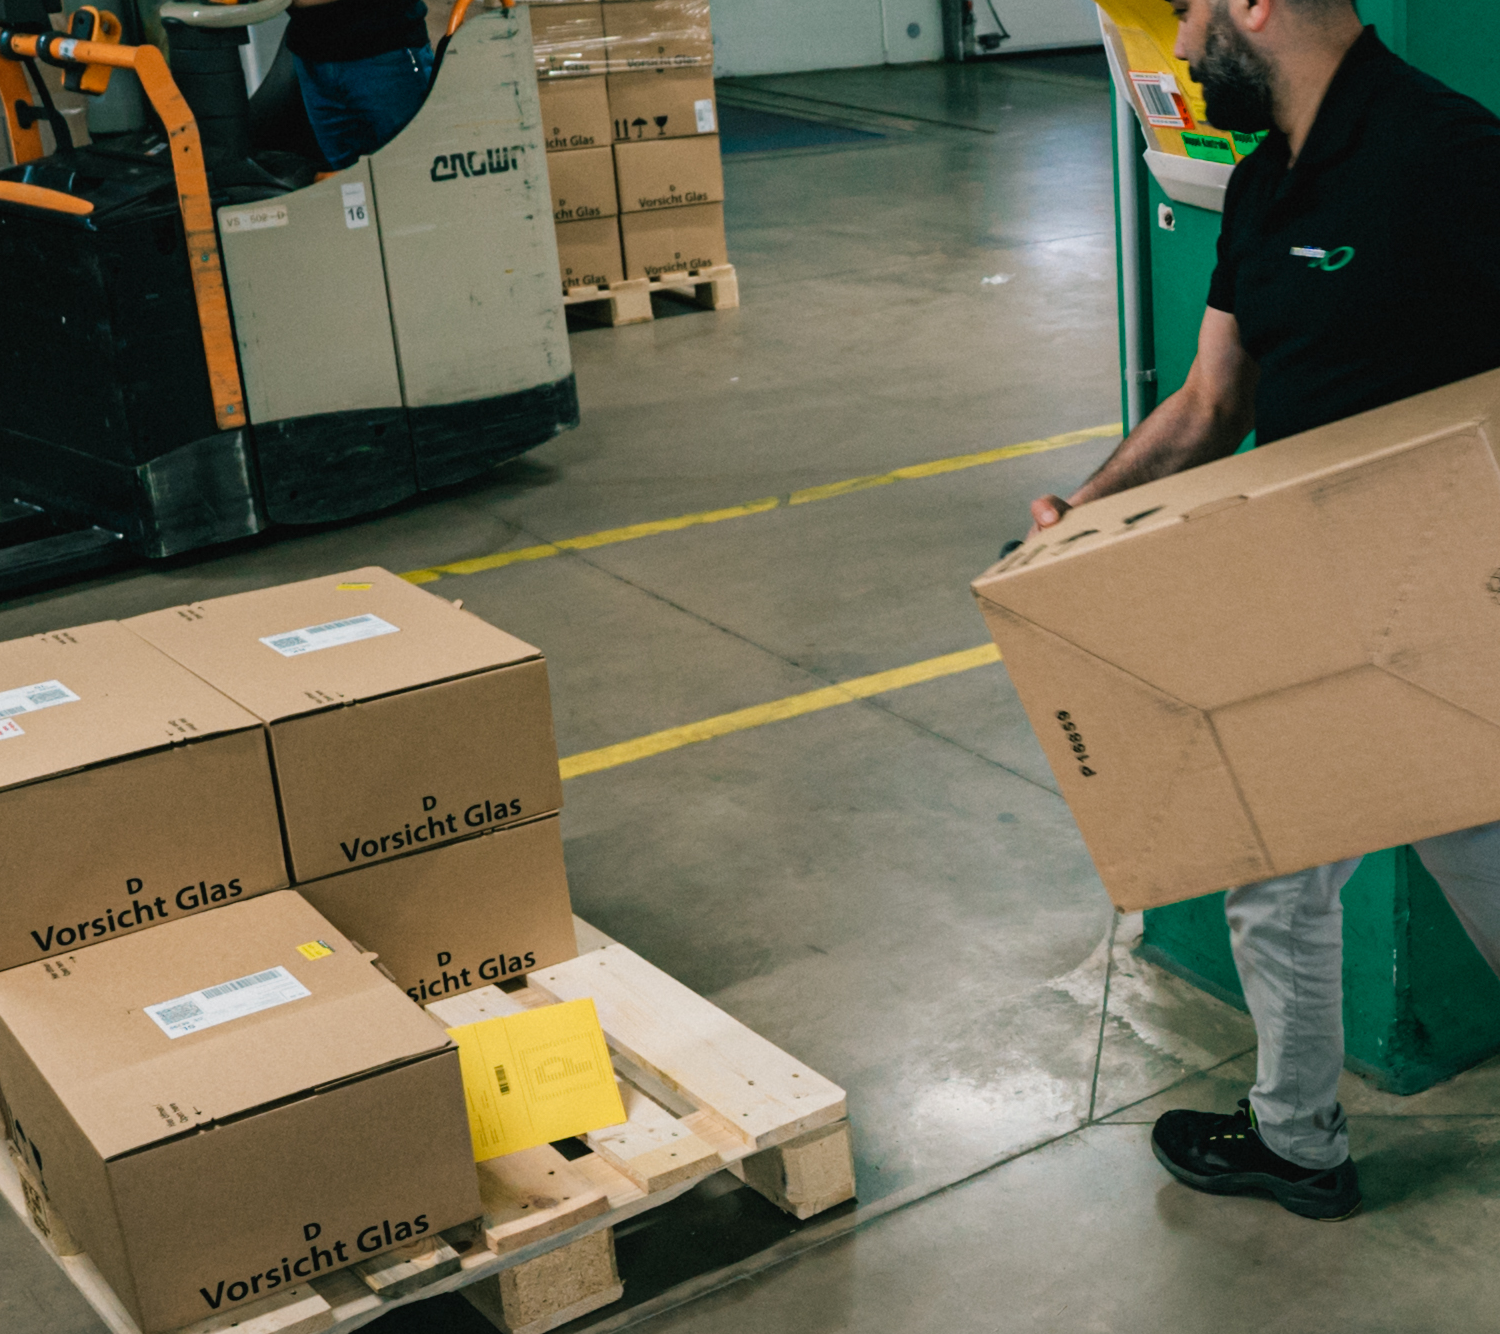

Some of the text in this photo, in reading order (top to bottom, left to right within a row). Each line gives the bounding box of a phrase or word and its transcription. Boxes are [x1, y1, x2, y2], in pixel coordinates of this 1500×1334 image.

[569, 134, 595, 147] Glas
[639, 191, 709, 208] Vorsicht Glas
[347, 207, 365, 221] 16
[576, 205, 602, 217] Glas
[644, 257, 713, 276] Vorsicht Glas
[581, 273, 607, 286] Glas
[422, 795, 438, 812] D
[340, 797, 522, 864] Vorsicht Glas
[126, 877, 143, 895] D
[30, 878, 243, 952] Vorsicht Glas
[437, 951, 452, 967] D
[406, 951, 536, 1003] sicht Glas
[303, 1222, 322, 1242] D
[199, 1214, 430, 1310] Vorsicht Glas
